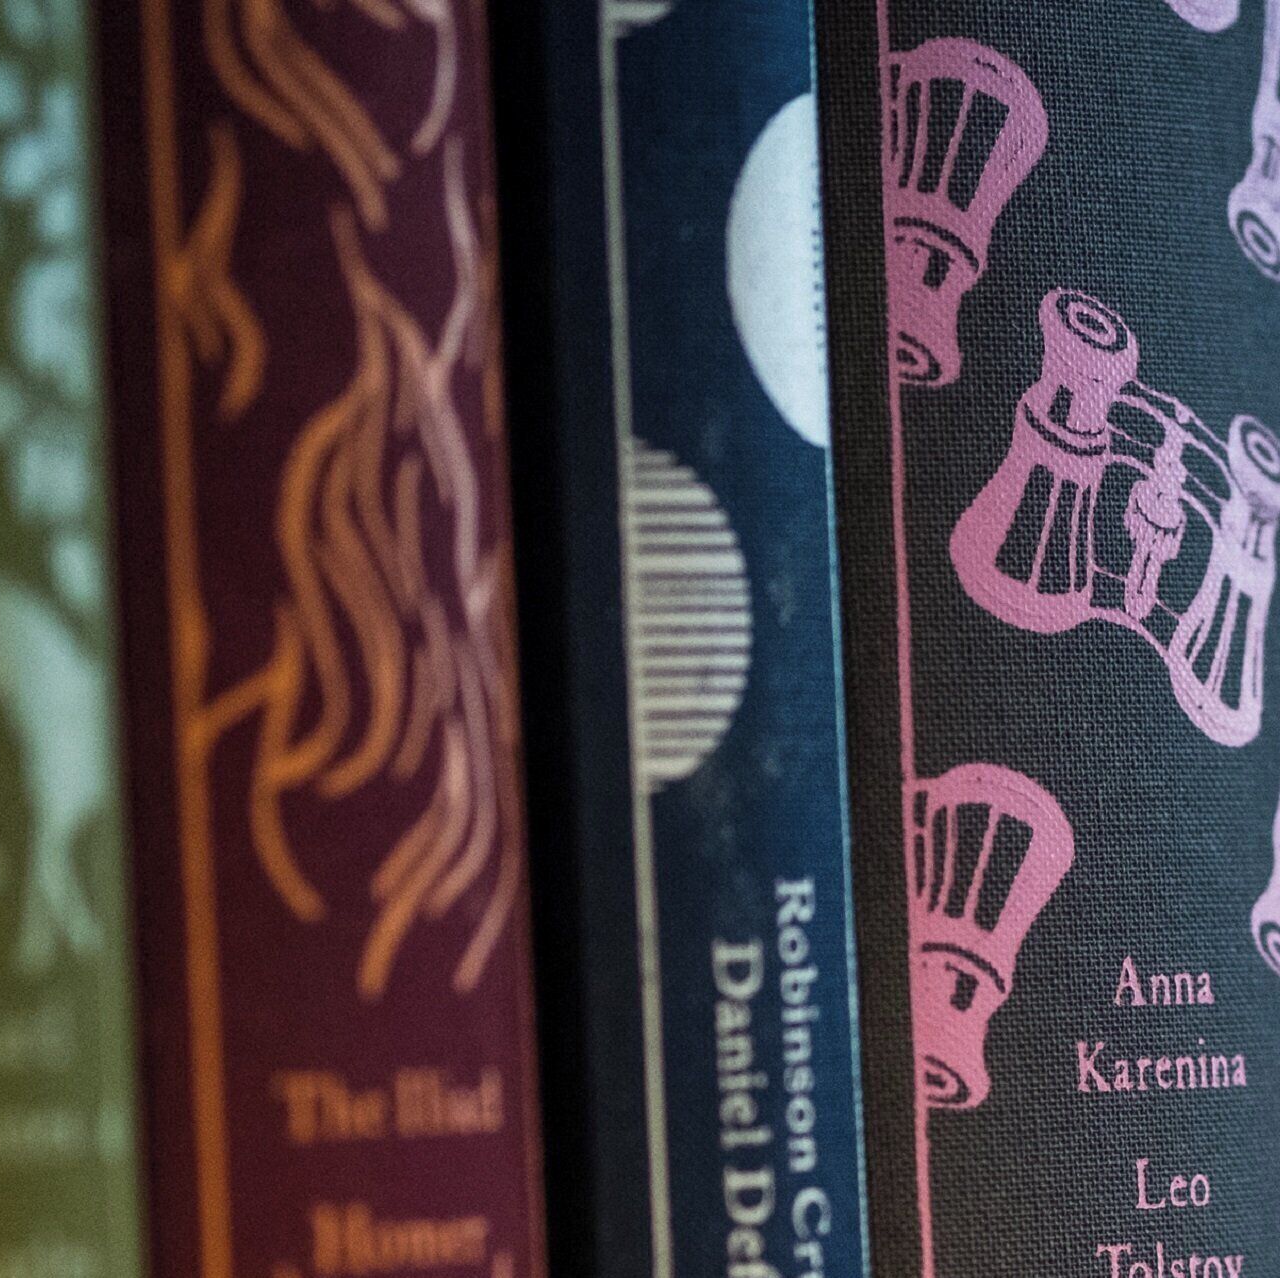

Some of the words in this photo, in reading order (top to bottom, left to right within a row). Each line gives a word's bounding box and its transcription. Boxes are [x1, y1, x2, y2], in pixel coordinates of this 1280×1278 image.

[1114, 955, 1215, 1006] Anna
[711, 937, 773, 1149] Daniel
[775, 876, 820, 1174] Robinson
[1076, 1038, 1248, 1093] Karenina
[279, 1069, 387, 1144] The
[1135, 1158, 1211, 1210] Leo
